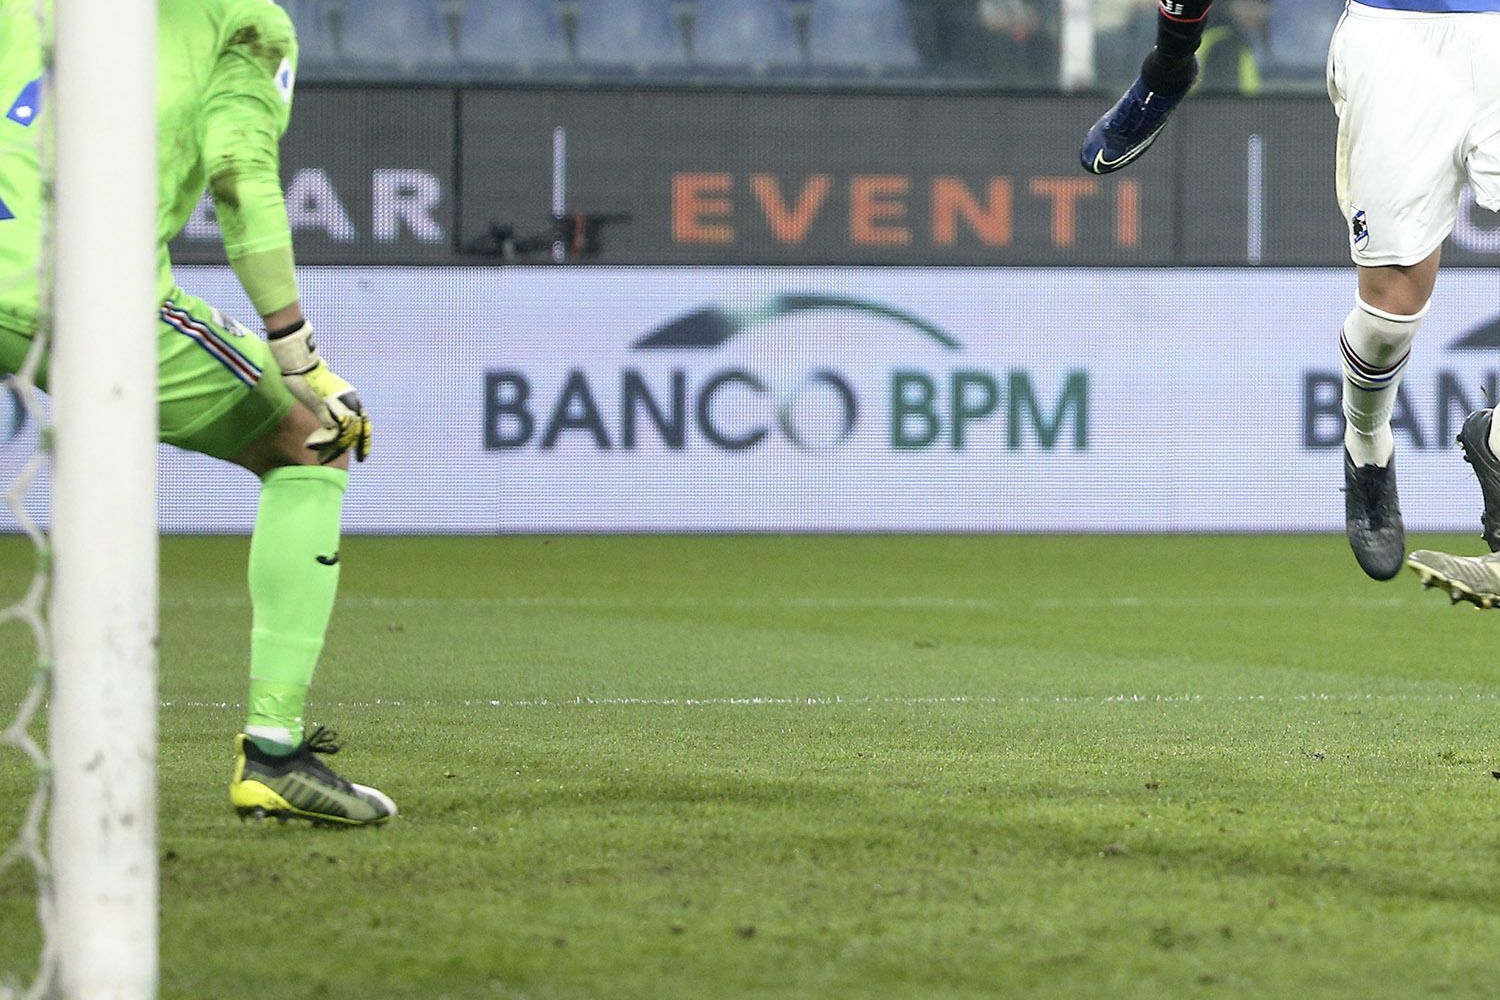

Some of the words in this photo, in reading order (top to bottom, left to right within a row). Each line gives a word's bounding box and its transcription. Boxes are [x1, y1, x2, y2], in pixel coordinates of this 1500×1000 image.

[671, 174, 1142, 248] EVENTI
[484, 367, 858, 451] BANCO
[891, 370, 1088, 450] BPM
